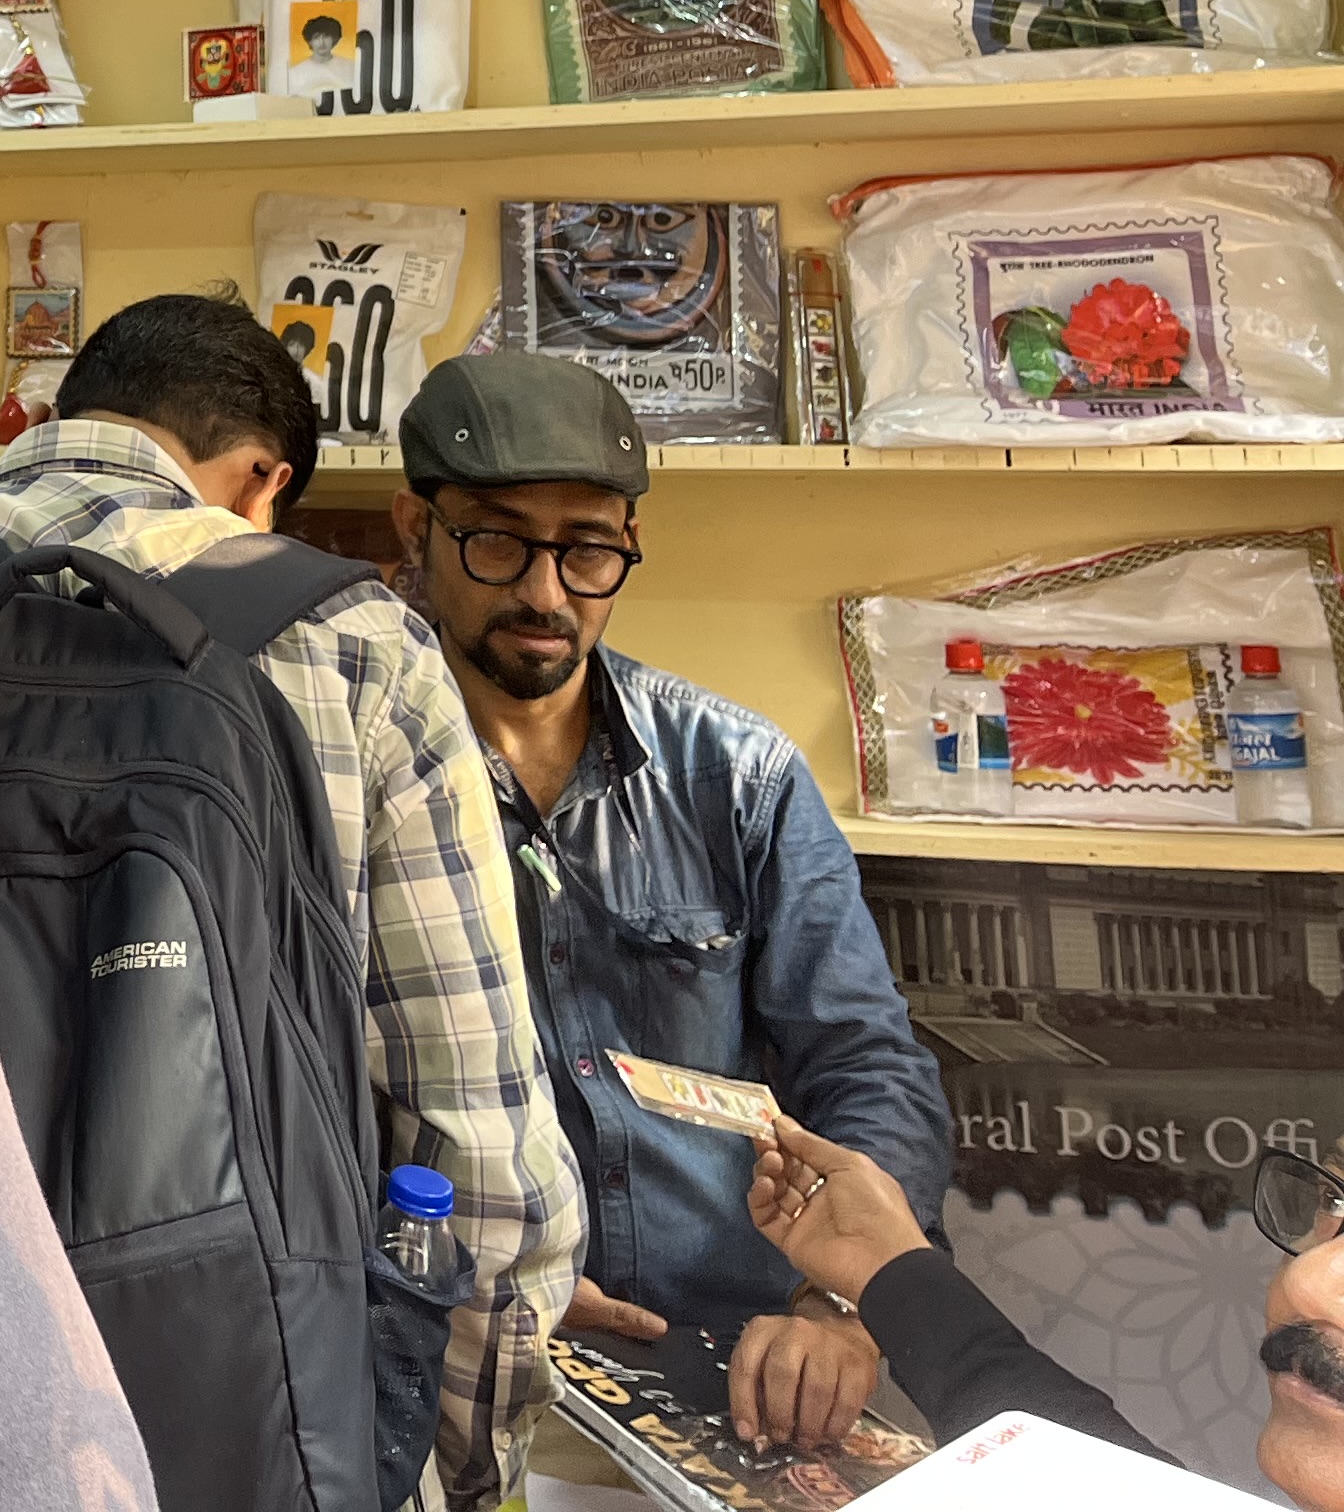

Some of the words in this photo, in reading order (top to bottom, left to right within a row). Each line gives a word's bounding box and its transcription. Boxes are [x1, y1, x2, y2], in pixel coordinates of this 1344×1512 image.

[1086, 399, 1145, 417] भारत
[90, 954, 188, 980] TOURISTER
[91, 940, 187, 968] AMERICAN
[958, 1100, 1039, 1154] ral
[1052, 1104, 1187, 1164] Post
